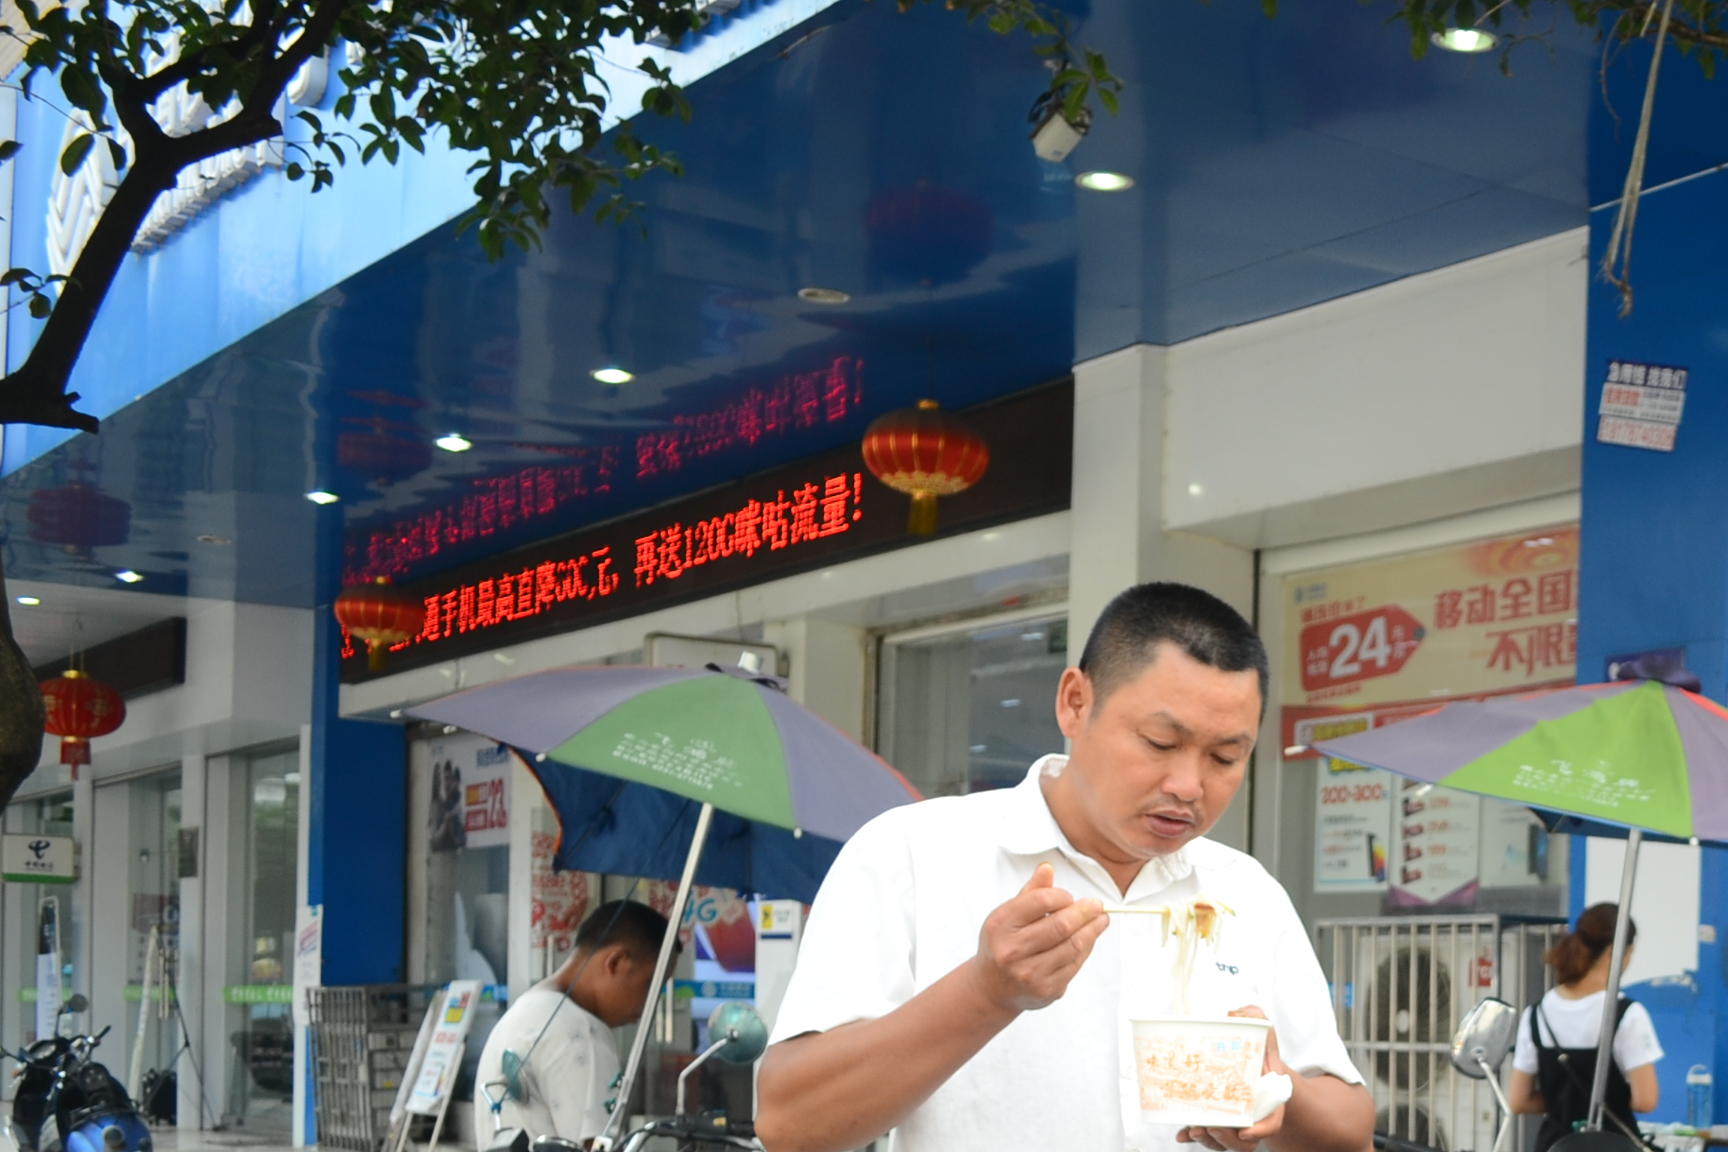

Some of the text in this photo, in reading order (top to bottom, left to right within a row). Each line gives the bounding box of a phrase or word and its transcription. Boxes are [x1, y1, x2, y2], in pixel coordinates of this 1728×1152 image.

[1435, 571, 1576, 629] 移动全国
[1329, 616, 1391, 679] 24
